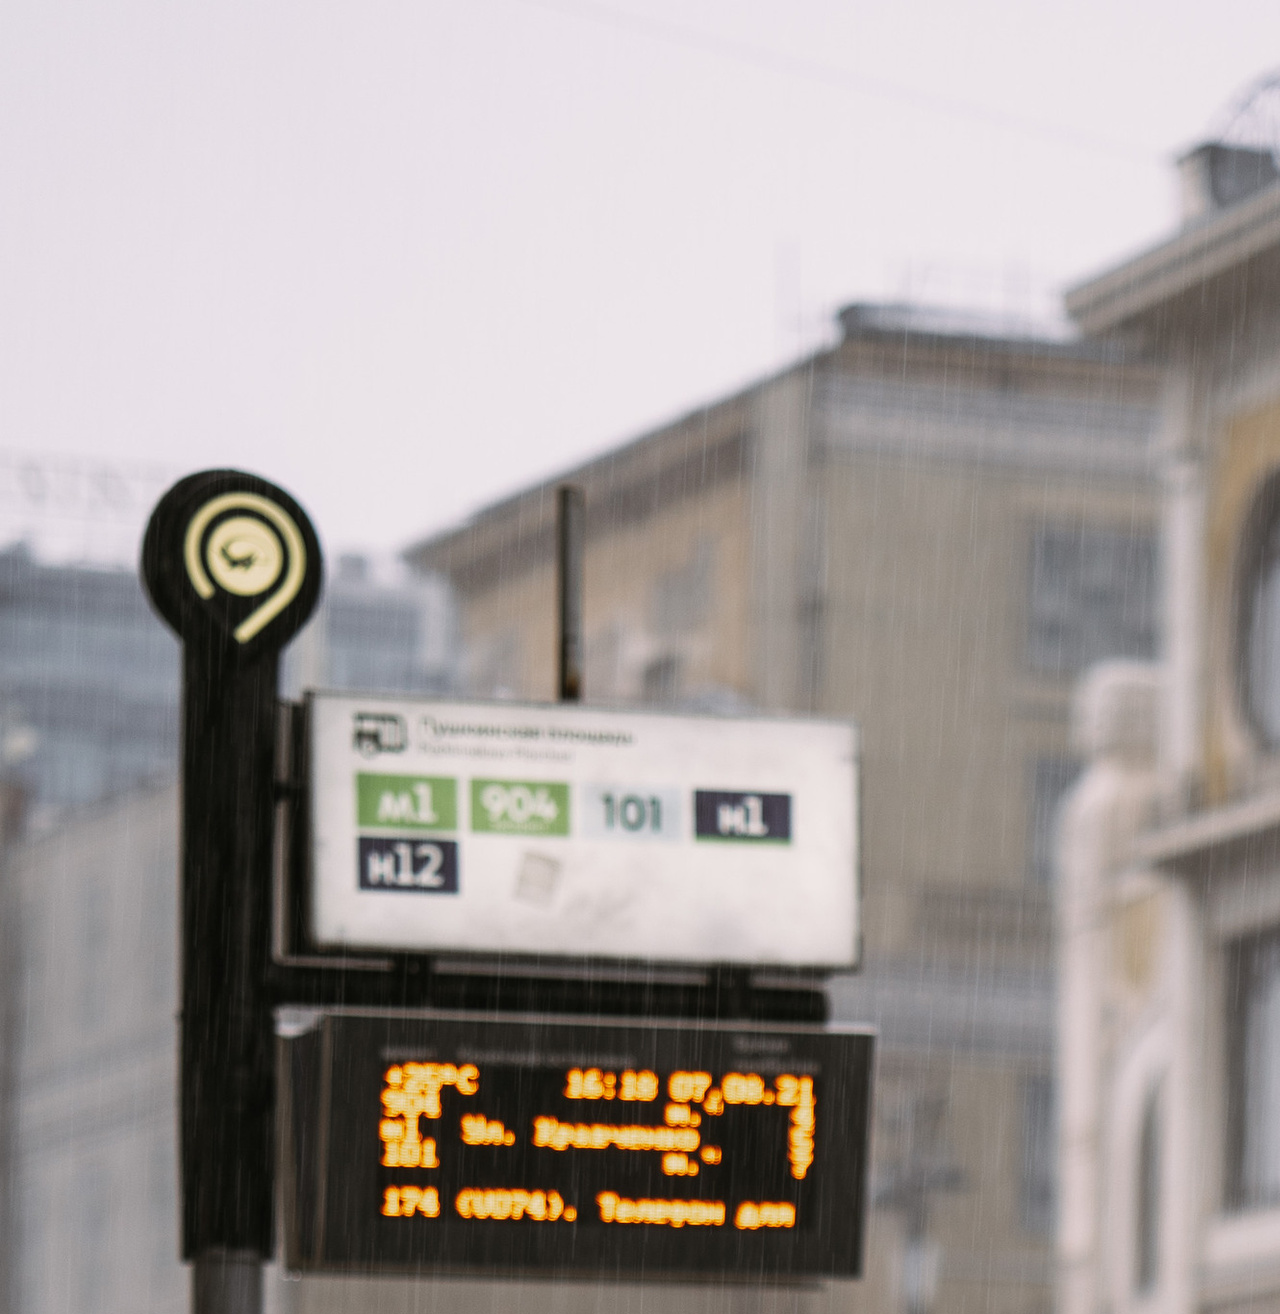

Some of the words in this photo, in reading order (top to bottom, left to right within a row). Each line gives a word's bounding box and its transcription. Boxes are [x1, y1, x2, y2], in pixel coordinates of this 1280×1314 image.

[480, 784, 560, 823] 904
[601, 793, 662, 832] 101
[382, 1139, 438, 1167] 101
